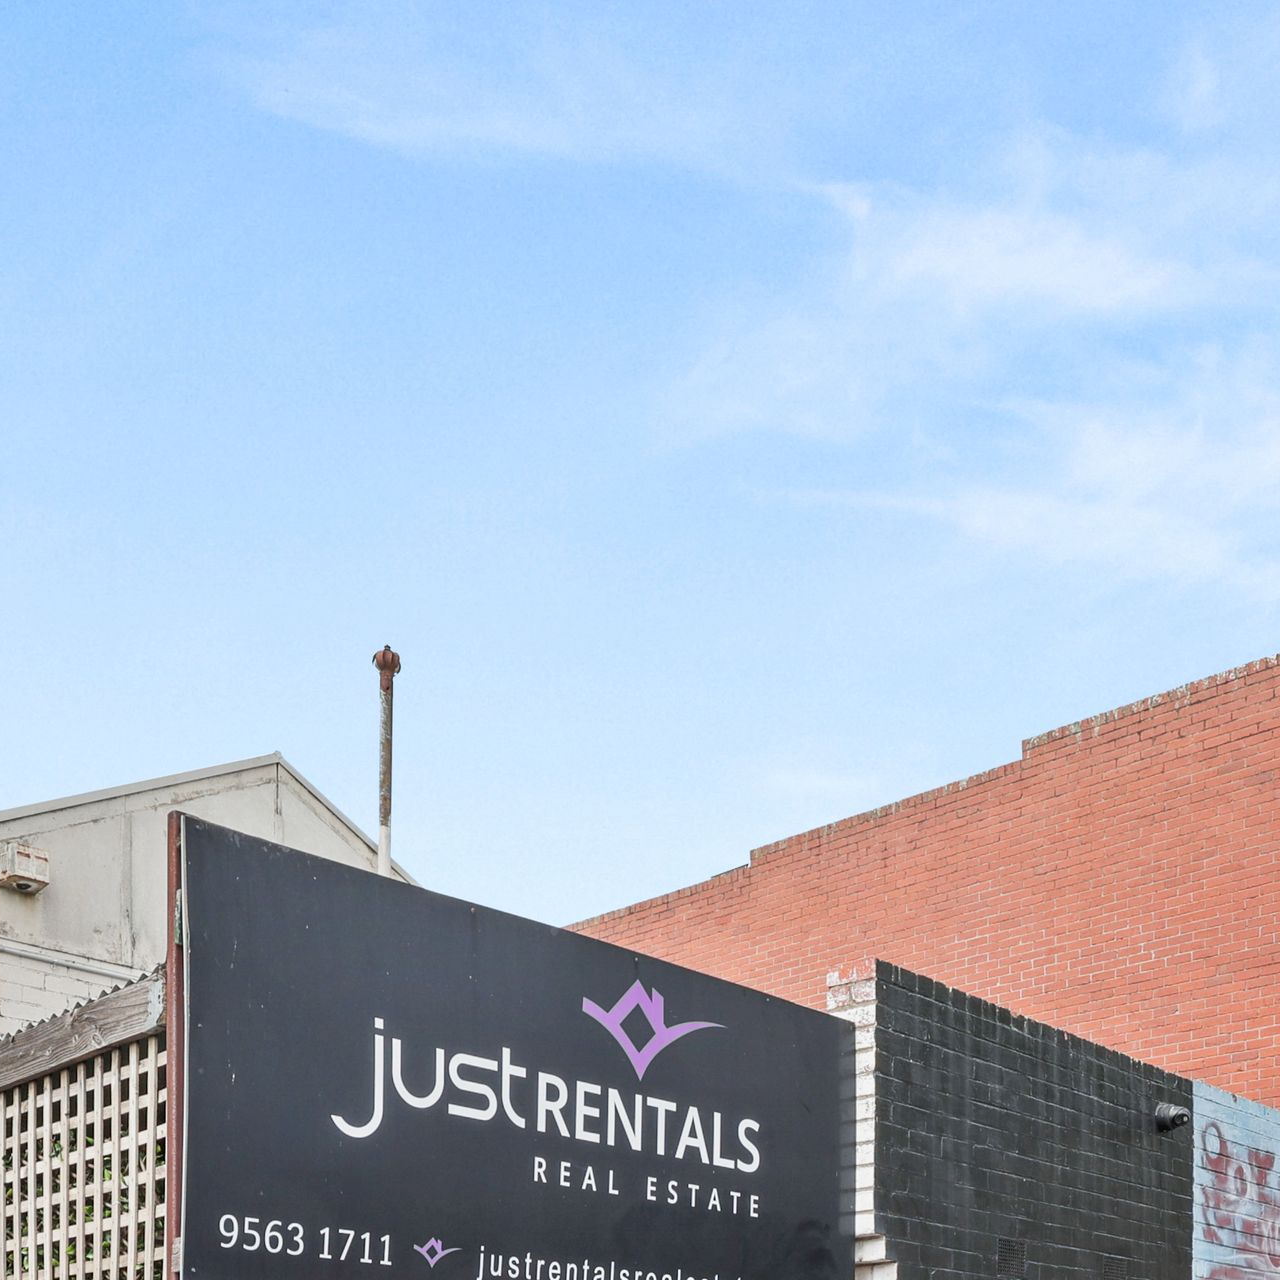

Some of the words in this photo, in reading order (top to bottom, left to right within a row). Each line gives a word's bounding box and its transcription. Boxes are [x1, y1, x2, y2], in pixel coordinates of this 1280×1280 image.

[330, 1017, 527, 1139] just
[536, 1071, 761, 1173] RENTALS
[533, 1156, 620, 1196] REAL
[646, 1176, 760, 1218] ESTATE
[218, 1213, 305, 1256] 9563
[318, 1226, 393, 1266] 1711
